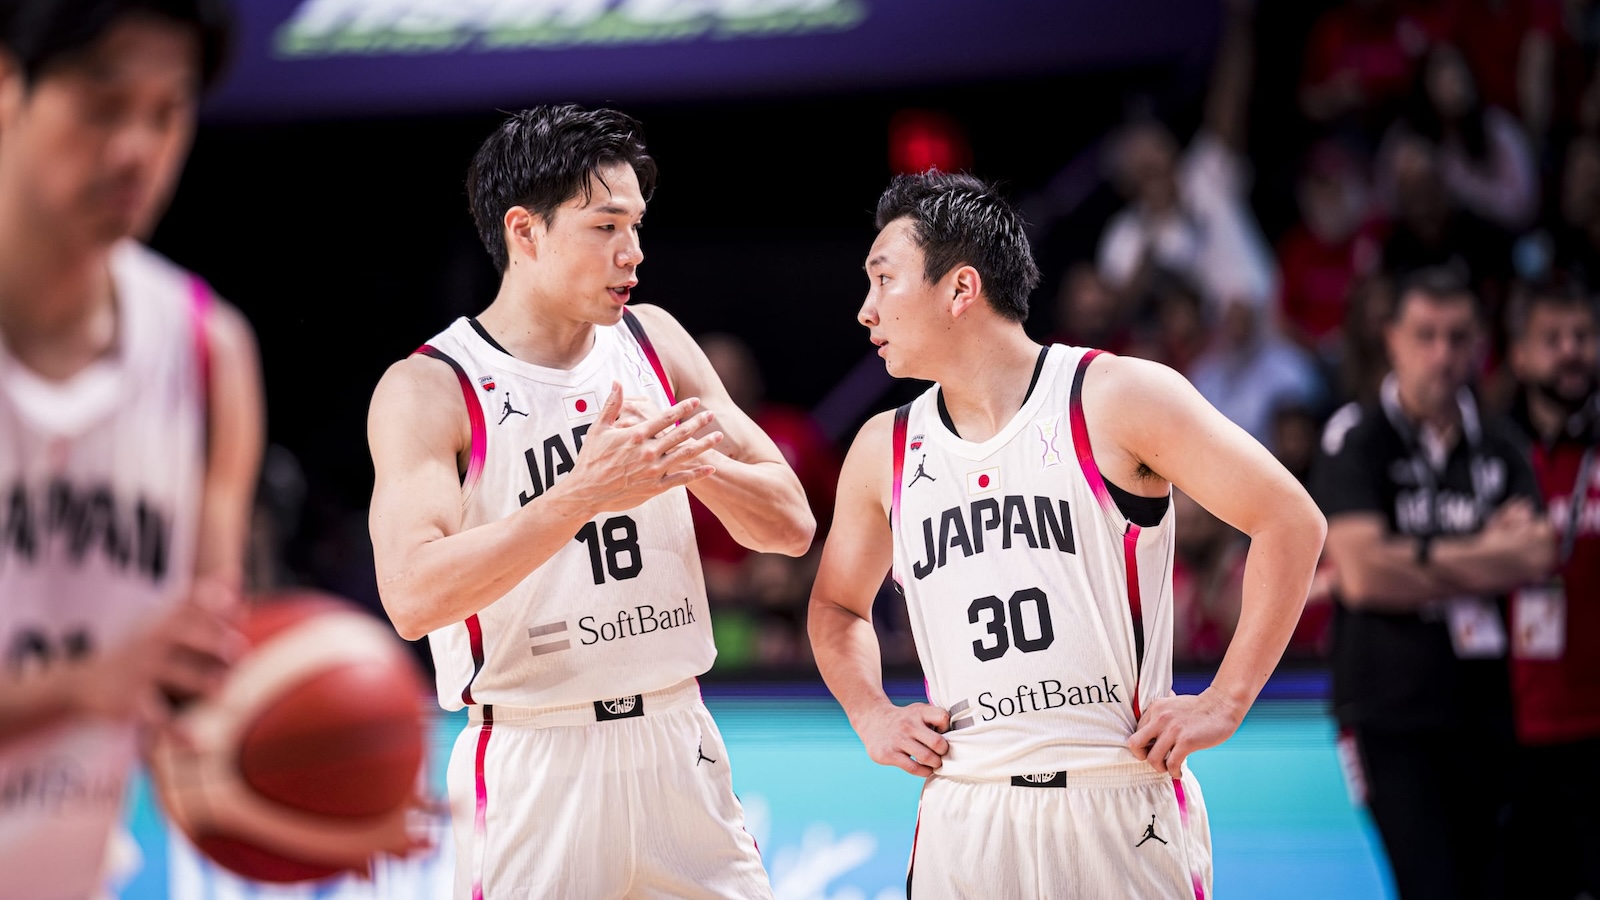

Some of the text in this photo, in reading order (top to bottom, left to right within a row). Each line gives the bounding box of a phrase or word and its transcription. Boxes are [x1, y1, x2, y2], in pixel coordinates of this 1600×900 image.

[574, 515, 643, 585] 18
[912, 495, 1076, 580] JAPAN
[578, 597, 696, 645] SoftBank
[967, 586, 1055, 662] 30
[977, 676, 1122, 722] SoftBank
